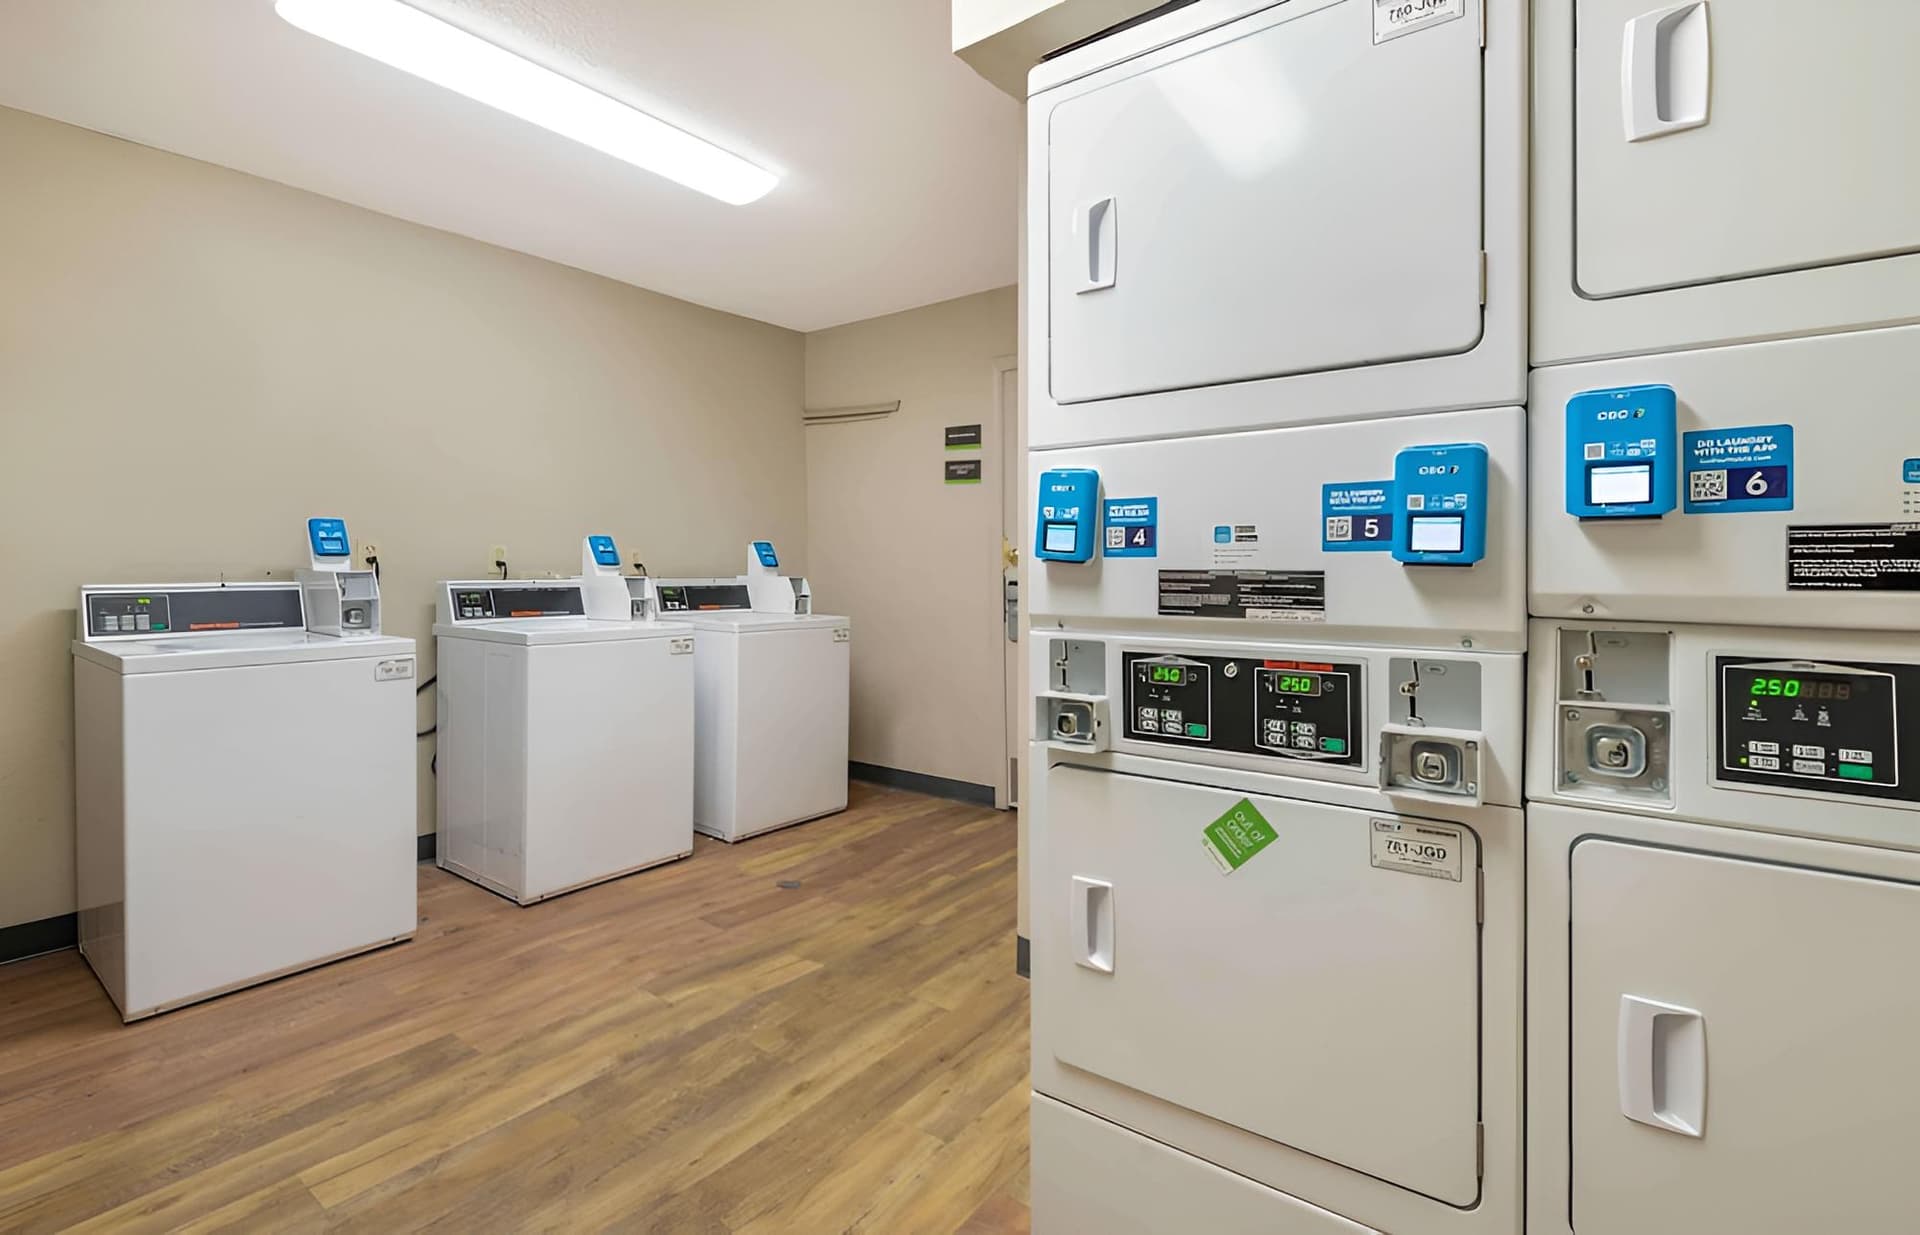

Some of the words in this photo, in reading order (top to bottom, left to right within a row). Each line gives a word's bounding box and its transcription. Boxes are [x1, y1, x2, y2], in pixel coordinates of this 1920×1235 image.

[1745, 471, 1769, 496] 6
[1132, 527, 1147, 546] 4
[1364, 518, 1380, 538] 5
